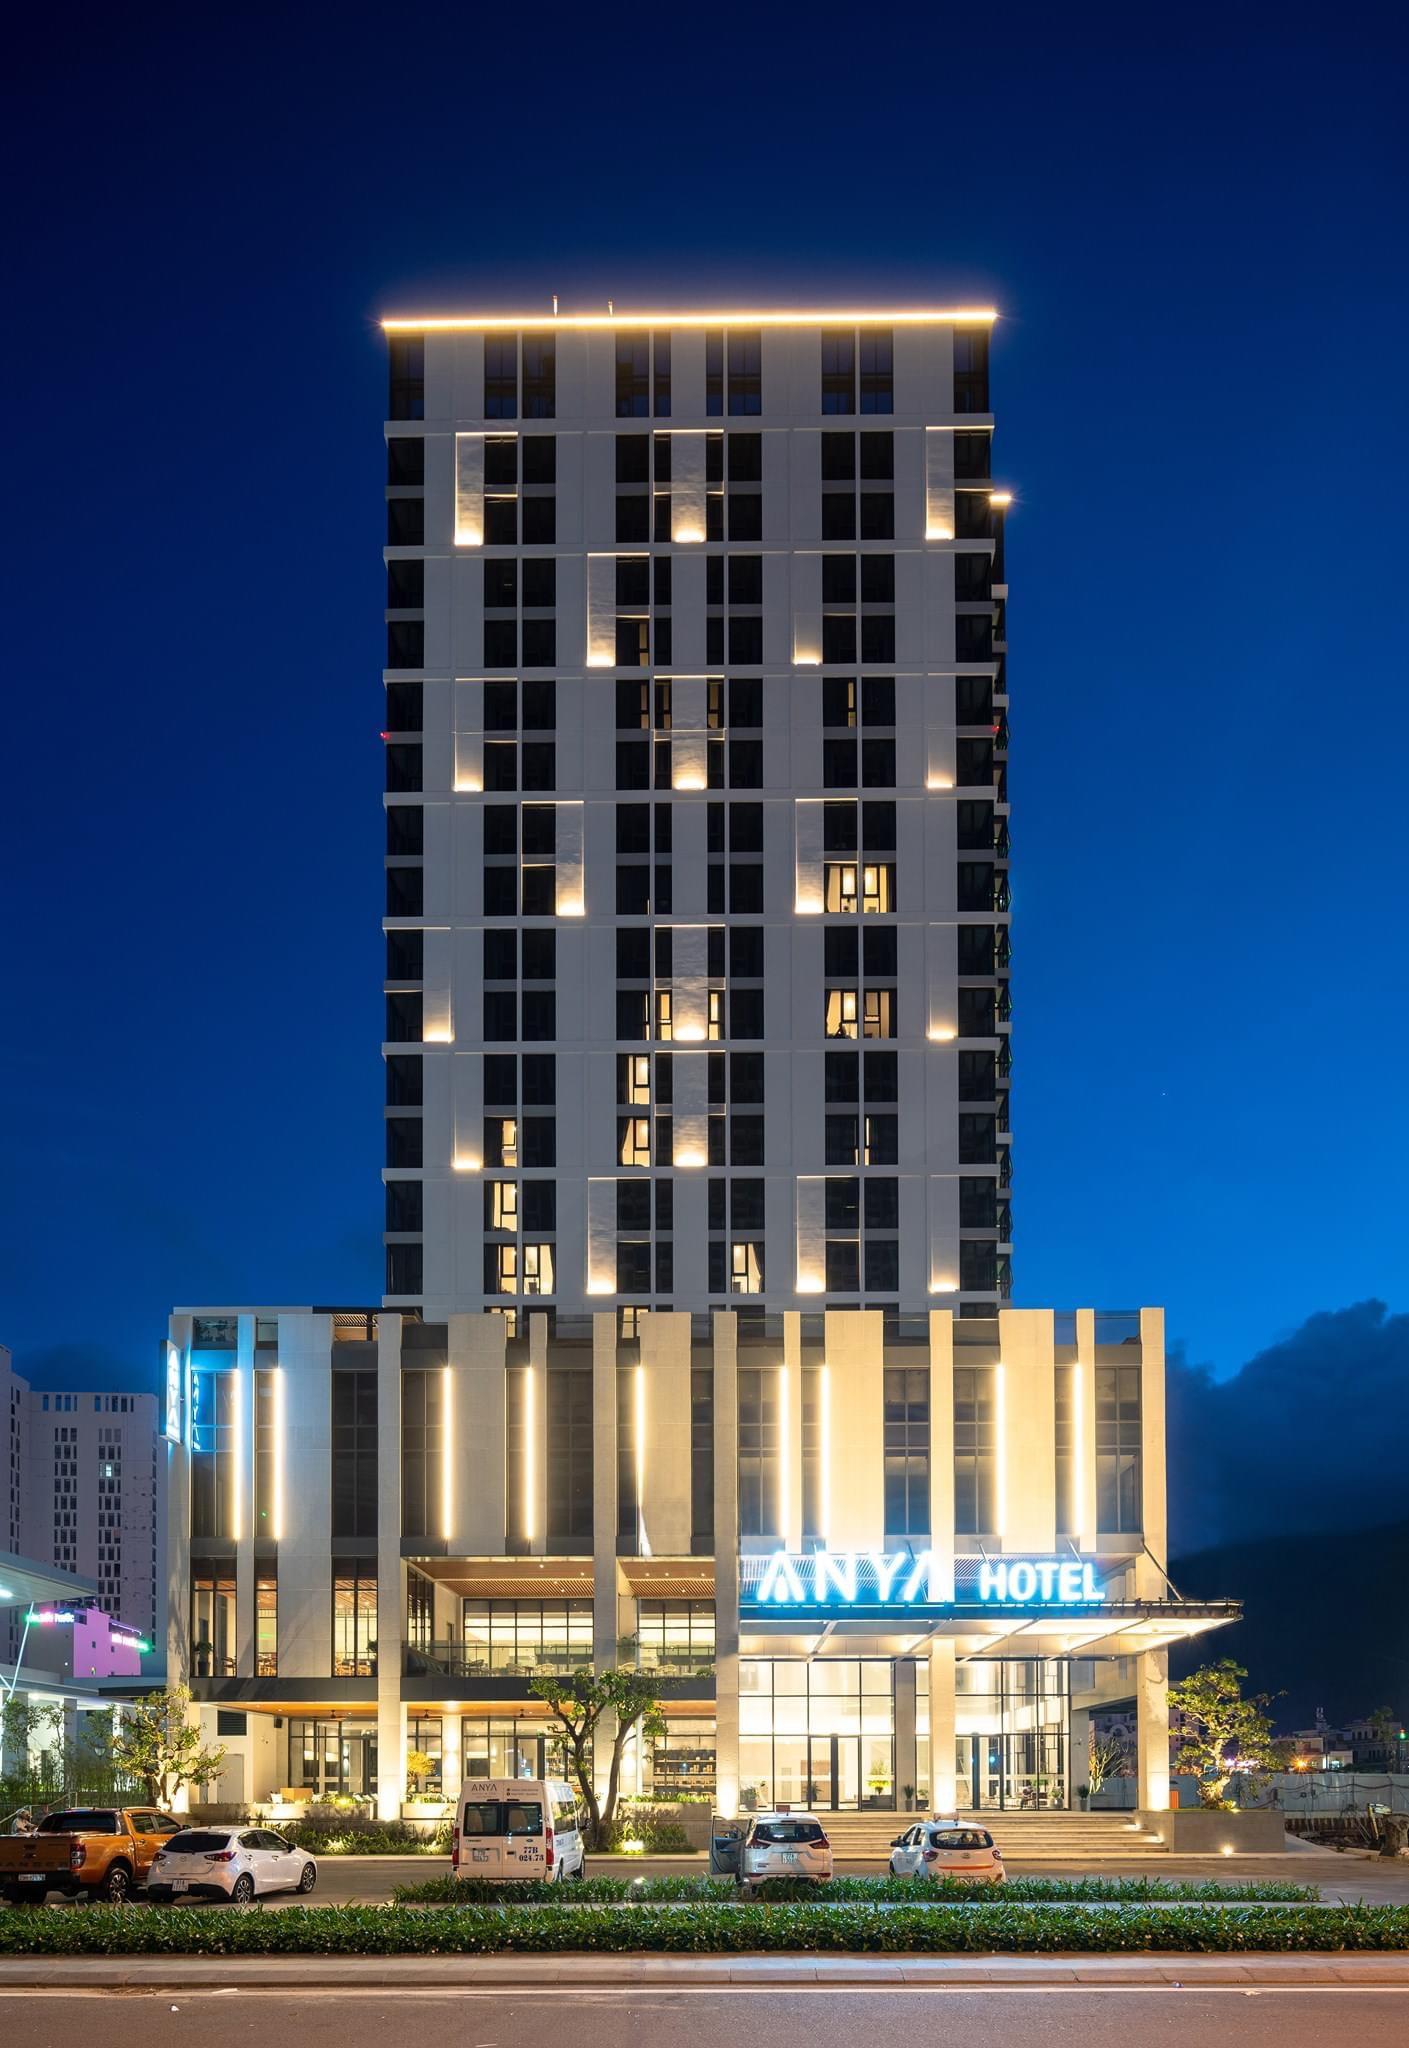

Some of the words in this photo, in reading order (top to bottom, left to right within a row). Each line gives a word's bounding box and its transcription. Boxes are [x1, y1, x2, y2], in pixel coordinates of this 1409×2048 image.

[979, 1561, 1105, 1601] HOTEL
[471, 1783, 497, 1792] ANYA
[523, 1846, 539, 1854] 77B
